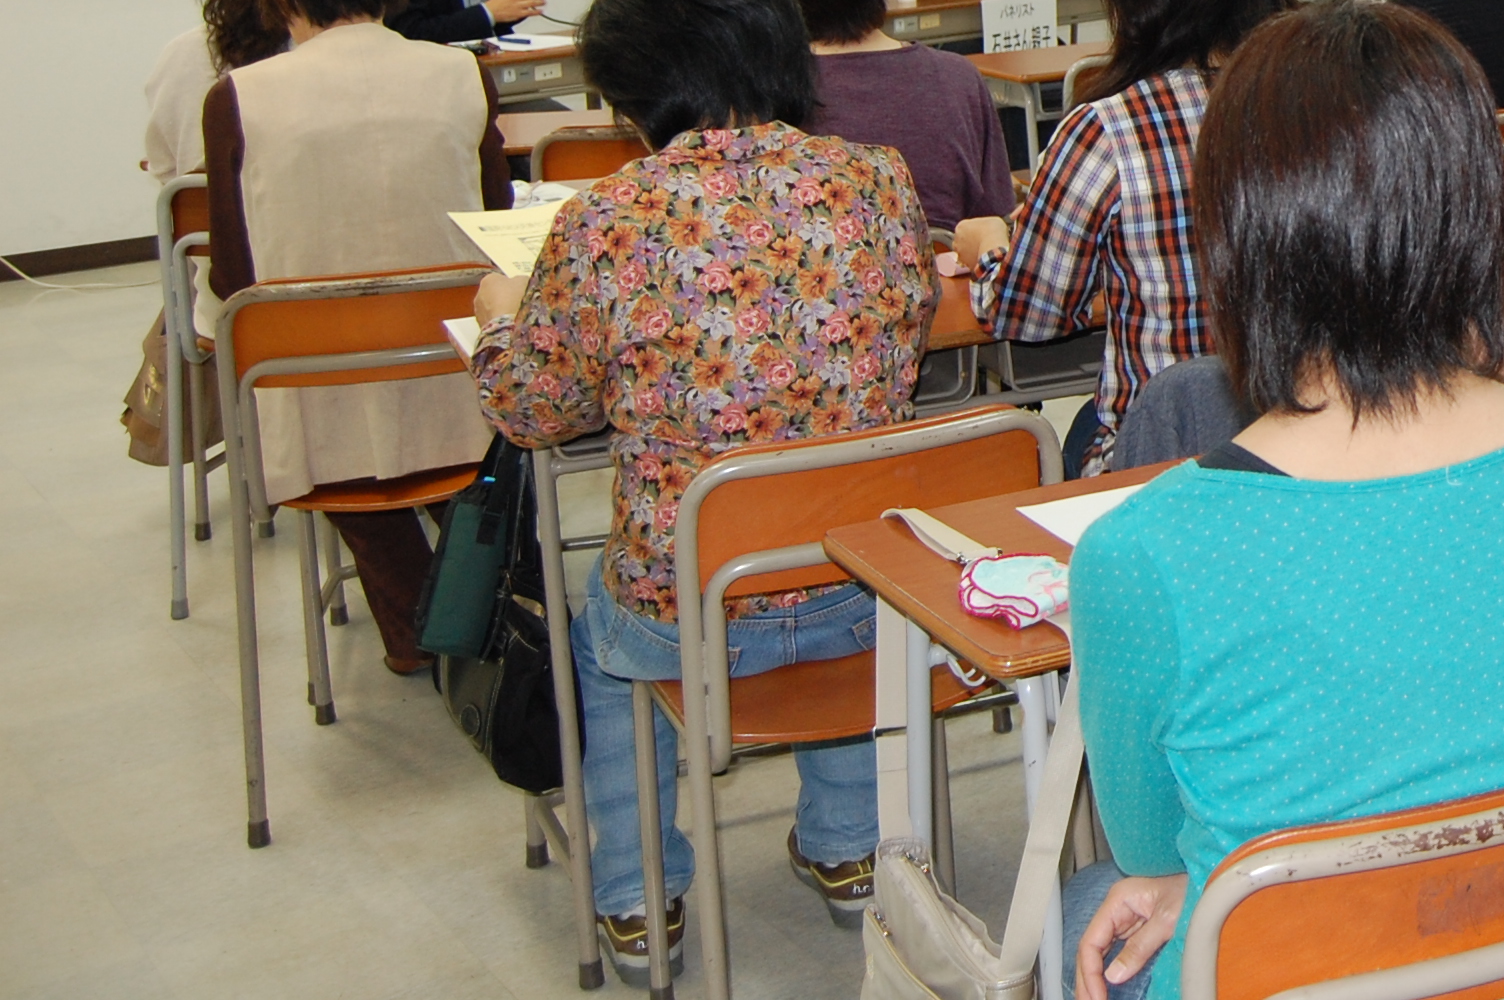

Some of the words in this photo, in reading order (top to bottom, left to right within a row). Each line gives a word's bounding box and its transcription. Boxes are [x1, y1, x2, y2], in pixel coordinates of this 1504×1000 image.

[1000, 2, 1035, 19] パネリスト
